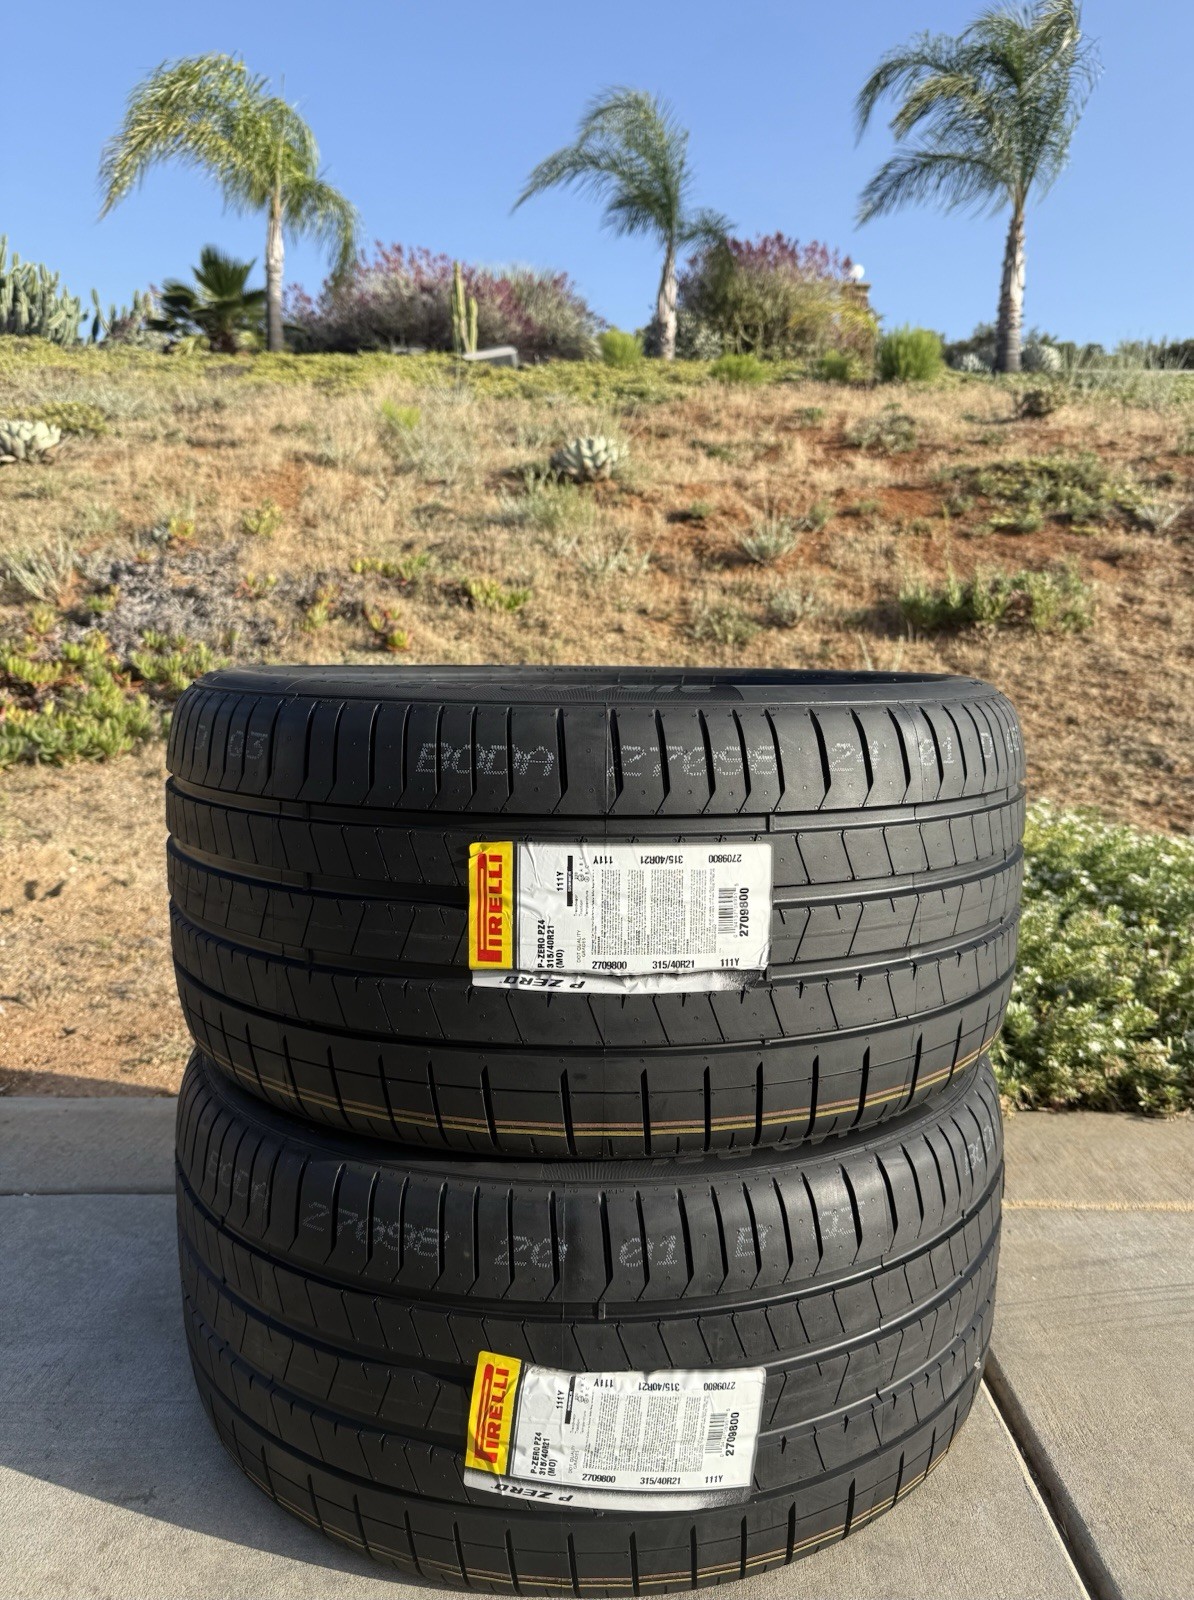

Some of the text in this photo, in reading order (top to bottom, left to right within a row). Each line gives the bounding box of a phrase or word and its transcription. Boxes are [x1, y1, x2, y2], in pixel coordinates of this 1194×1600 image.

[593, 854, 742, 864] 2709800 315/40R21 111Y
[556, 871, 564, 891] 111Y
[477, 853, 503, 962] PIRELLI
[739, 887, 750, 937] 2709800
[537, 919, 546, 968] P-ZERO PZ4
[546, 925, 555, 968] 315/40R21
[556, 949, 565, 968] (MO)
[592, 958, 739, 970] 2709800 315/40R21 111Y
[503, 976, 564, 988] ZERO
[593, 1378, 613, 1388] 111Y
[704, 1382, 736, 1391] 2709800
[556, 1390, 564, 1409] 111Y
[474, 1363, 509, 1463] PIRELLI
[725, 1412, 740, 1457] 2709800
[530, 1432, 542, 1474] P-ZERO PZ4
[548, 1459, 558, 1476] (MO)
[639, 1476, 681, 1485] 315/40R21
[705, 1474, 723, 1484] 111Y
[494, 1483, 553, 1499] ZERO
